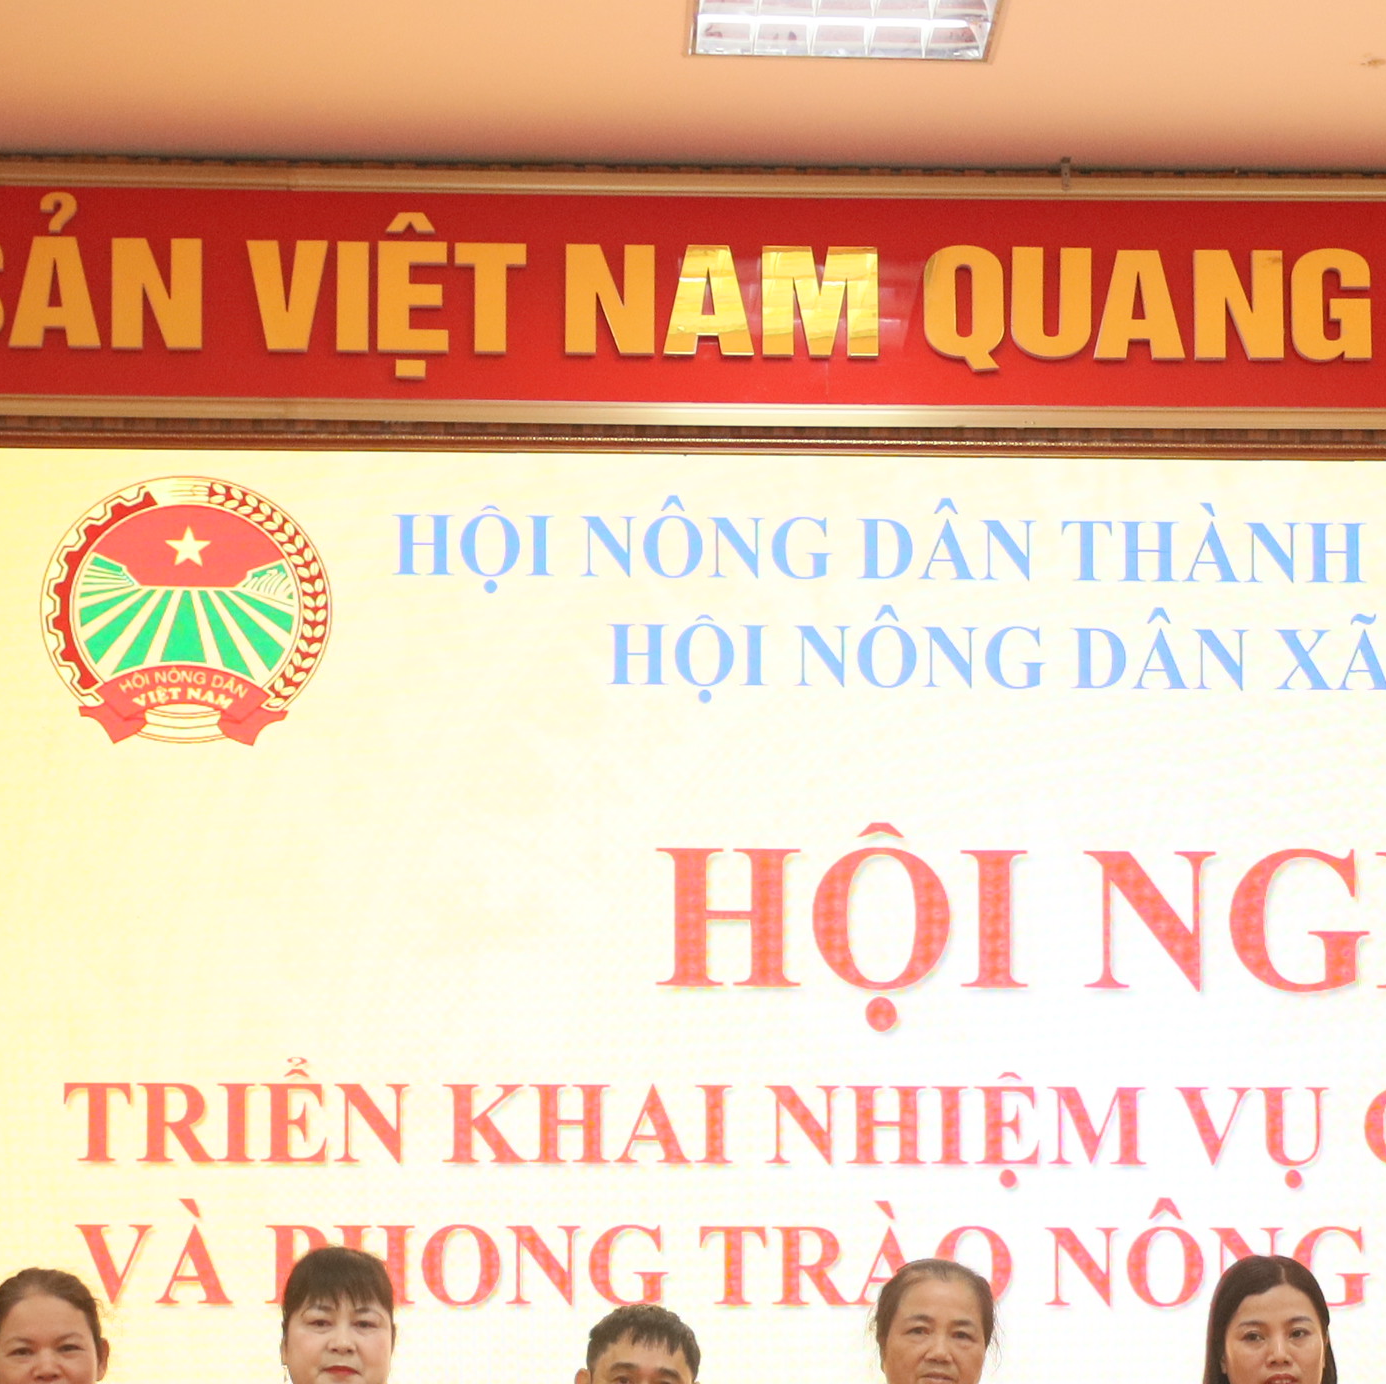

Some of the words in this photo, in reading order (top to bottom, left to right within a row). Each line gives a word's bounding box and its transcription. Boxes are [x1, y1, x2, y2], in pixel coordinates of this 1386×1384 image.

[246, 211, 528, 379] VIỆT
[566, 243, 880, 359] NAM
[924, 245, 1373, 373] QUANG
[394, 502, 555, 595] HỘI
[580, 494, 832, 581] NÔNG
[859, 497, 1038, 583] DÂN
[1062, 501, 1367, 585] THÀNH
[119, 672, 151, 693] HỘI
[155, 667, 207, 686] NÔNG
[211, 670, 248, 698] DÂN
[133, 687, 181, 708] VIỆT
[187, 688, 233, 709] NAM
[609, 612, 767, 705] HỘI
[795, 604, 1045, 691] NÔNG
[1072, 606, 1251, 691] DÂN
[655, 822, 1030, 1033] HỘI
[63, 1056, 410, 1165] TRIỂN
[442, 1082, 734, 1166] KHAI
[765, 1072, 1147, 1190] NHIỆM
[1176, 1085, 1325, 1190] VỤ
[75, 1198, 235, 1307] VÀ
